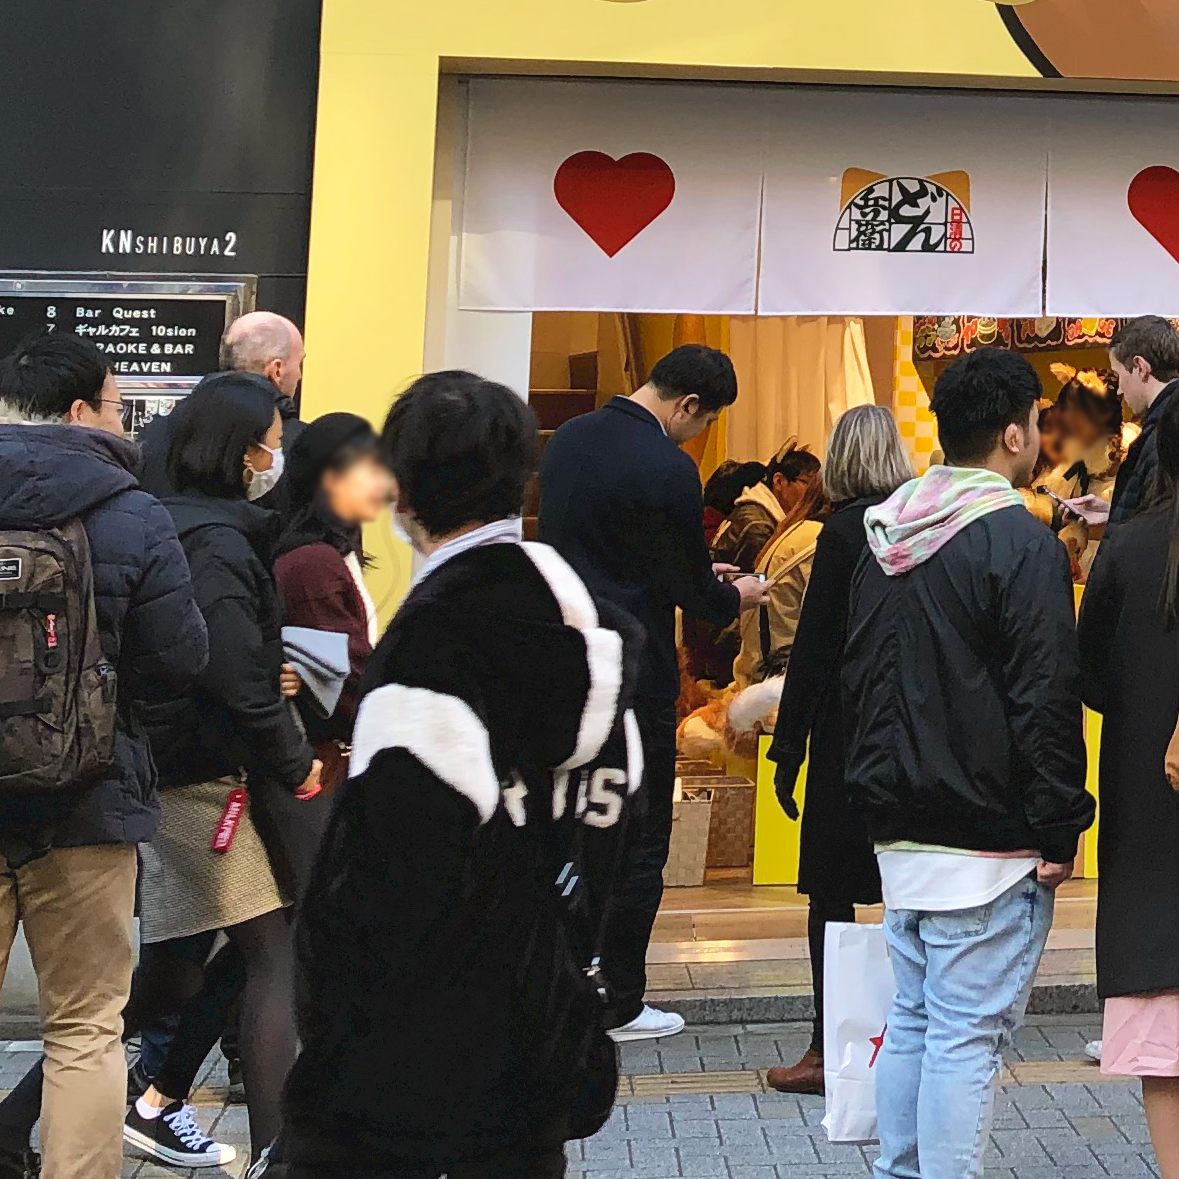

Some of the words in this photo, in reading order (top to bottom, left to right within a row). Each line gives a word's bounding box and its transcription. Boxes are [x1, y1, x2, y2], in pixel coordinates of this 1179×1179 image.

[46, 305, 57, 318] 8
[75, 307, 102, 318] Bar
[112, 307, 157, 319] Quest
[75, 324, 140, 336] ギャルカフェ
[150, 343, 161, 354] &
[164, 343, 195, 355] BAR
